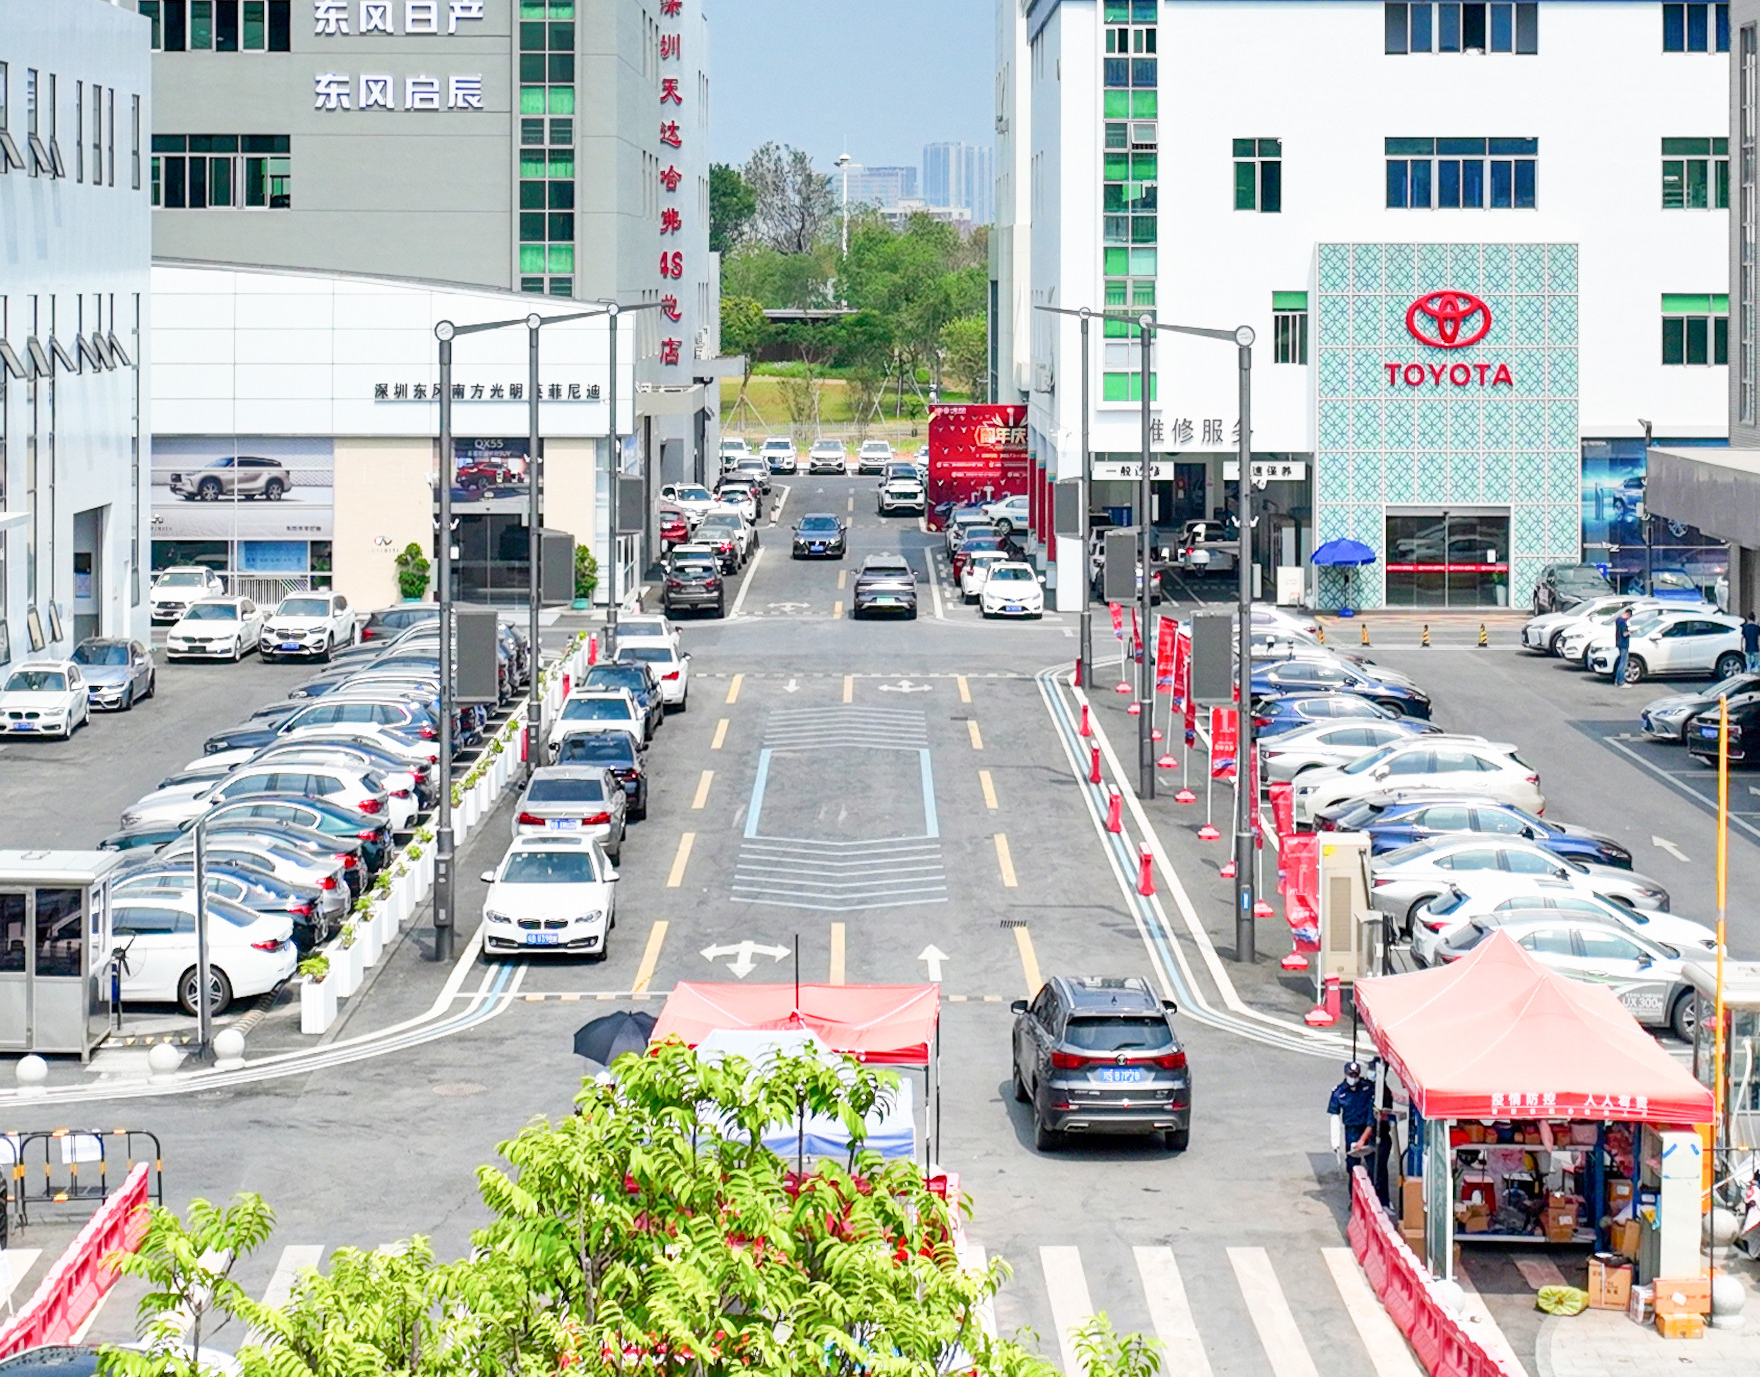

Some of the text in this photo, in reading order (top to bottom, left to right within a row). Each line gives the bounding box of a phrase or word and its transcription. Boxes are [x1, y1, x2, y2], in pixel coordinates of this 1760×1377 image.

[314, 73, 484, 111] 东风启辰
[1384, 363, 1514, 386] TOYOTA
[474, 438, 504, 450] QX55
[1237, 465, 1293, 477] 速保养
[1491, 1092, 1648, 1109] 疫情防控 人人有责
